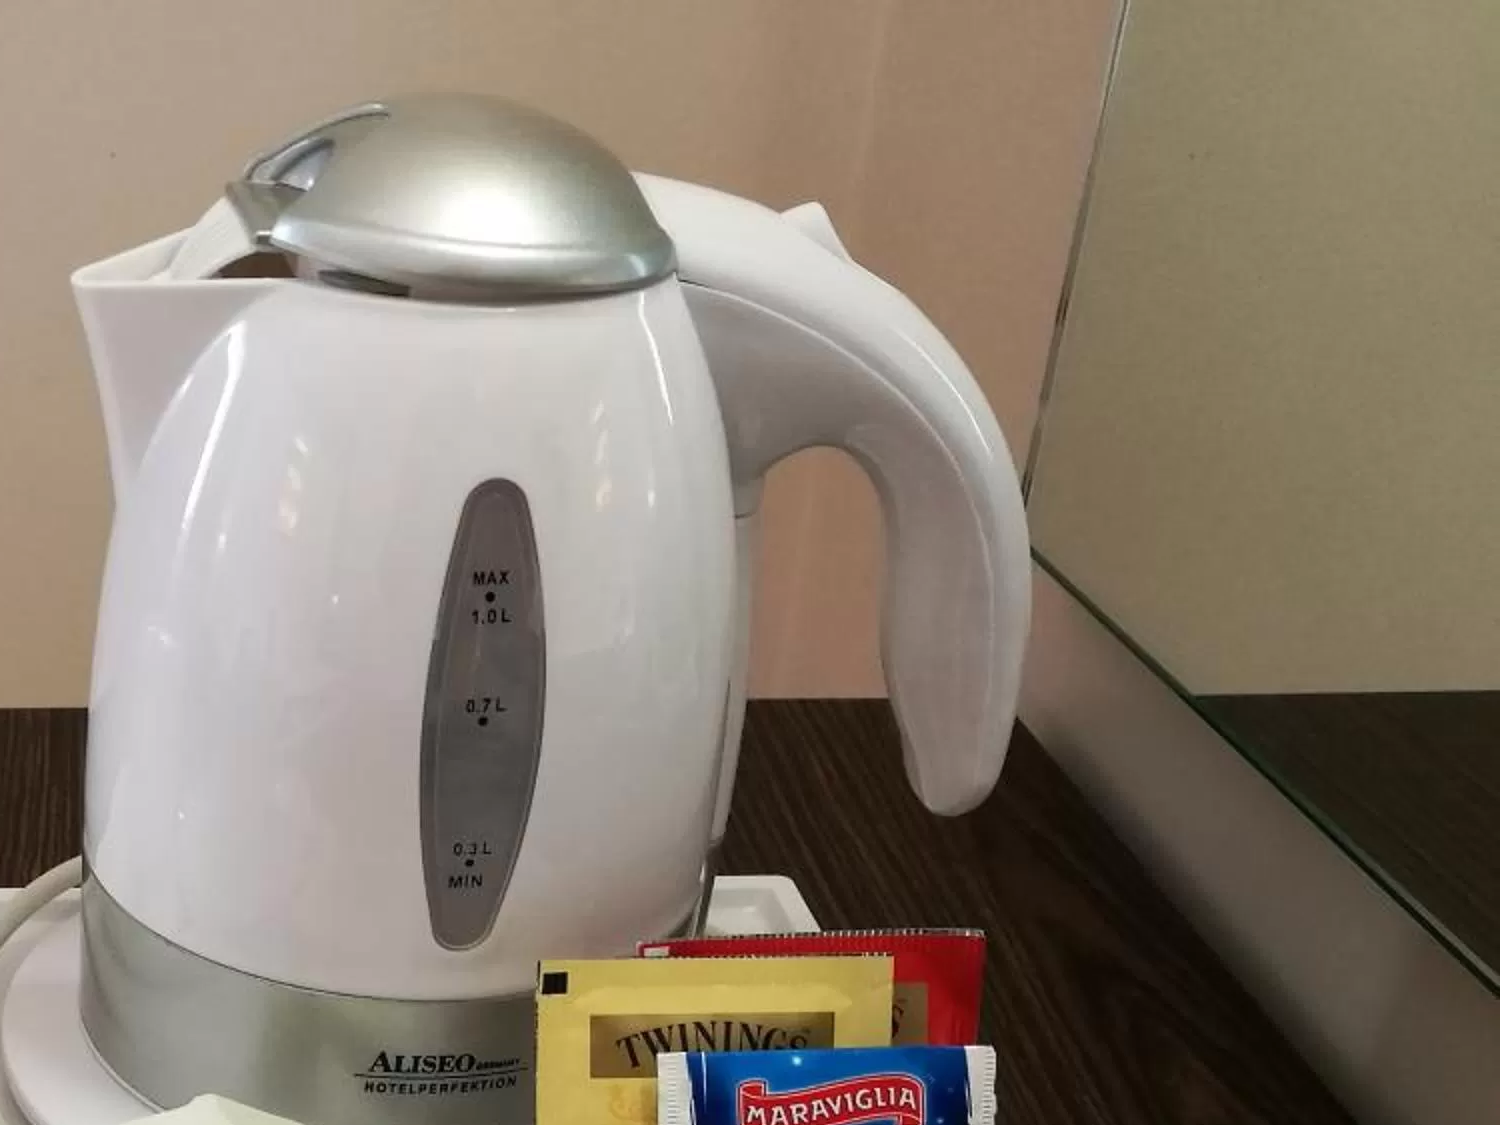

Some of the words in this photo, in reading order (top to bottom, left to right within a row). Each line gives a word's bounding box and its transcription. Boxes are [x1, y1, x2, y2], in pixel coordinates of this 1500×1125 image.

[473, 571, 510, 585] MAX
[448, 874, 483, 889] MIN
[368, 1050, 476, 1074] ALISEO
[364, 1075, 518, 1095] HOTELPERFEKTION
